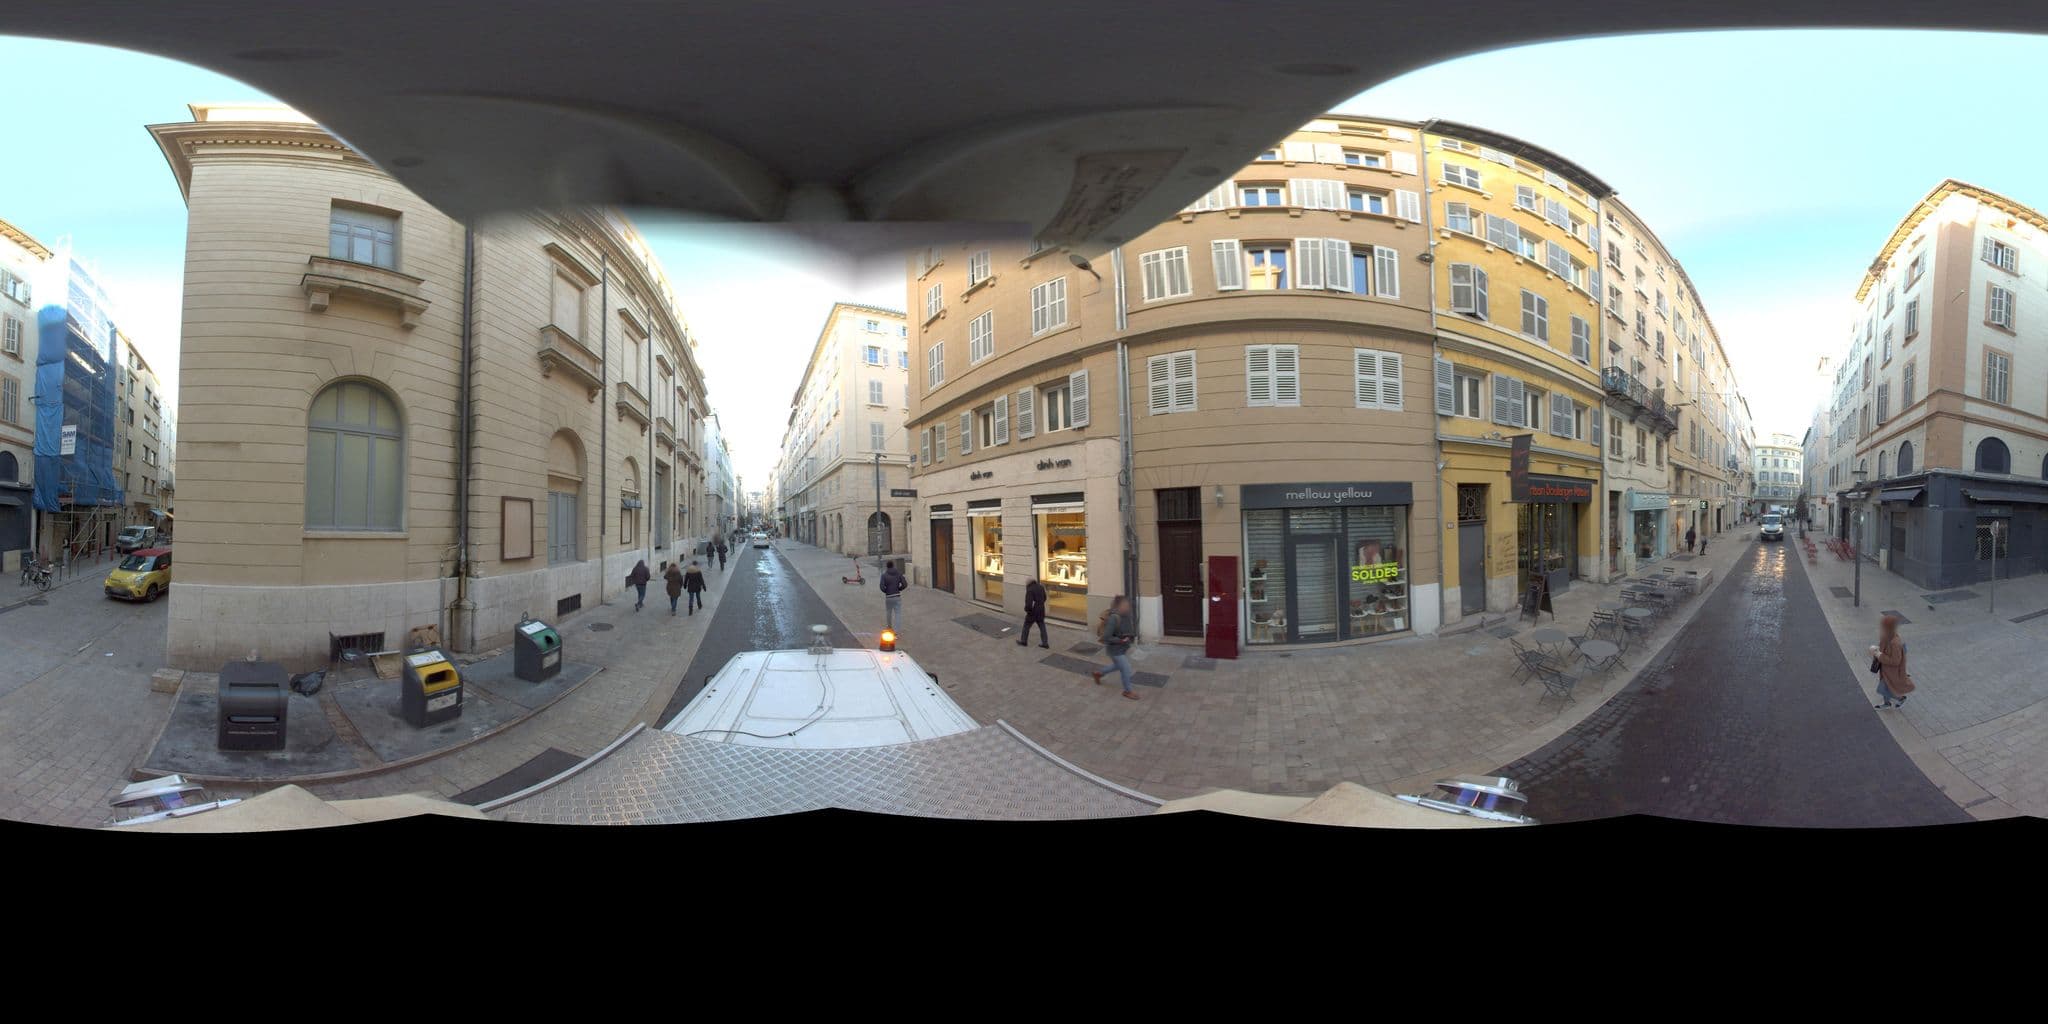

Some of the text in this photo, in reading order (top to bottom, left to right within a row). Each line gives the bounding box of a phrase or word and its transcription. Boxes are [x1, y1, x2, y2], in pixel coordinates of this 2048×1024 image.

[1037, 458, 1072, 471] dinh van
[983, 471, 994, 479] van
[1286, 487, 1373, 503] mellow yellow
[1352, 567, 1398, 580] SOLDES
